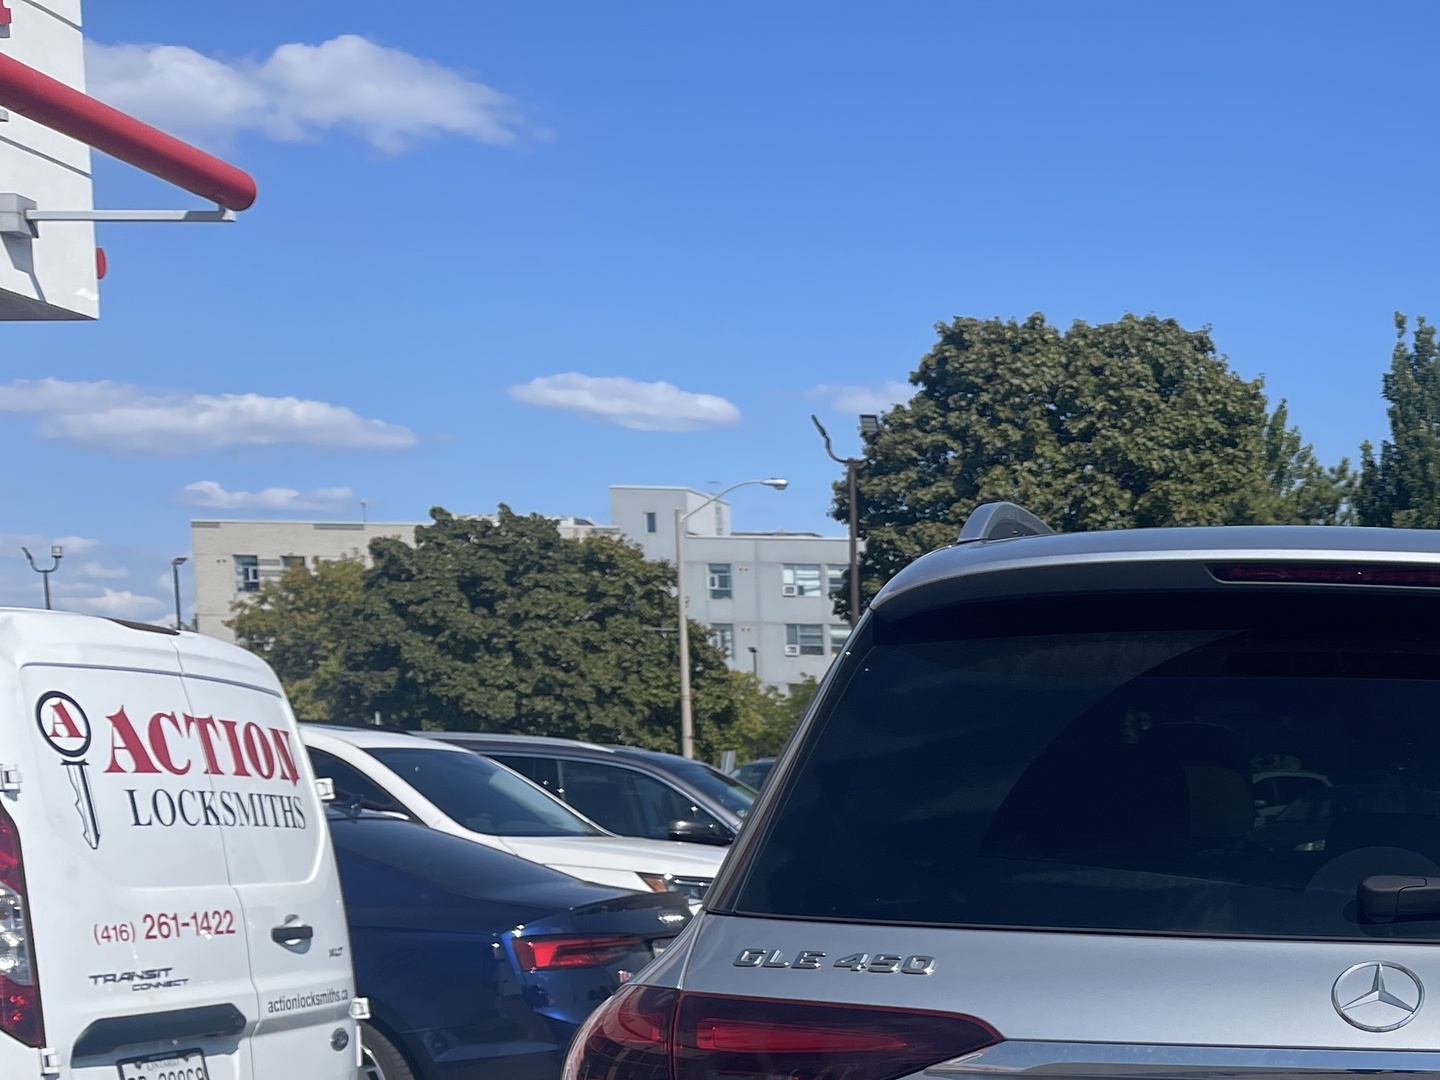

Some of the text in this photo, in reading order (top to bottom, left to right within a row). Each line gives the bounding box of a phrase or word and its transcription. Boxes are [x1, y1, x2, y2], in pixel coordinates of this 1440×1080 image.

[103, 705, 300, 786] ACTION
[124, 788, 306, 830] LOCKSMITHS
[94, 909, 236, 945] (416) 261-1422
[732, 948, 937, 975] GLE 450
[88, 967, 173, 985] TRANSIT
[131, 978, 190, 992] CONNECT
[267, 988, 349, 1013] actionlocksmiths.ca
